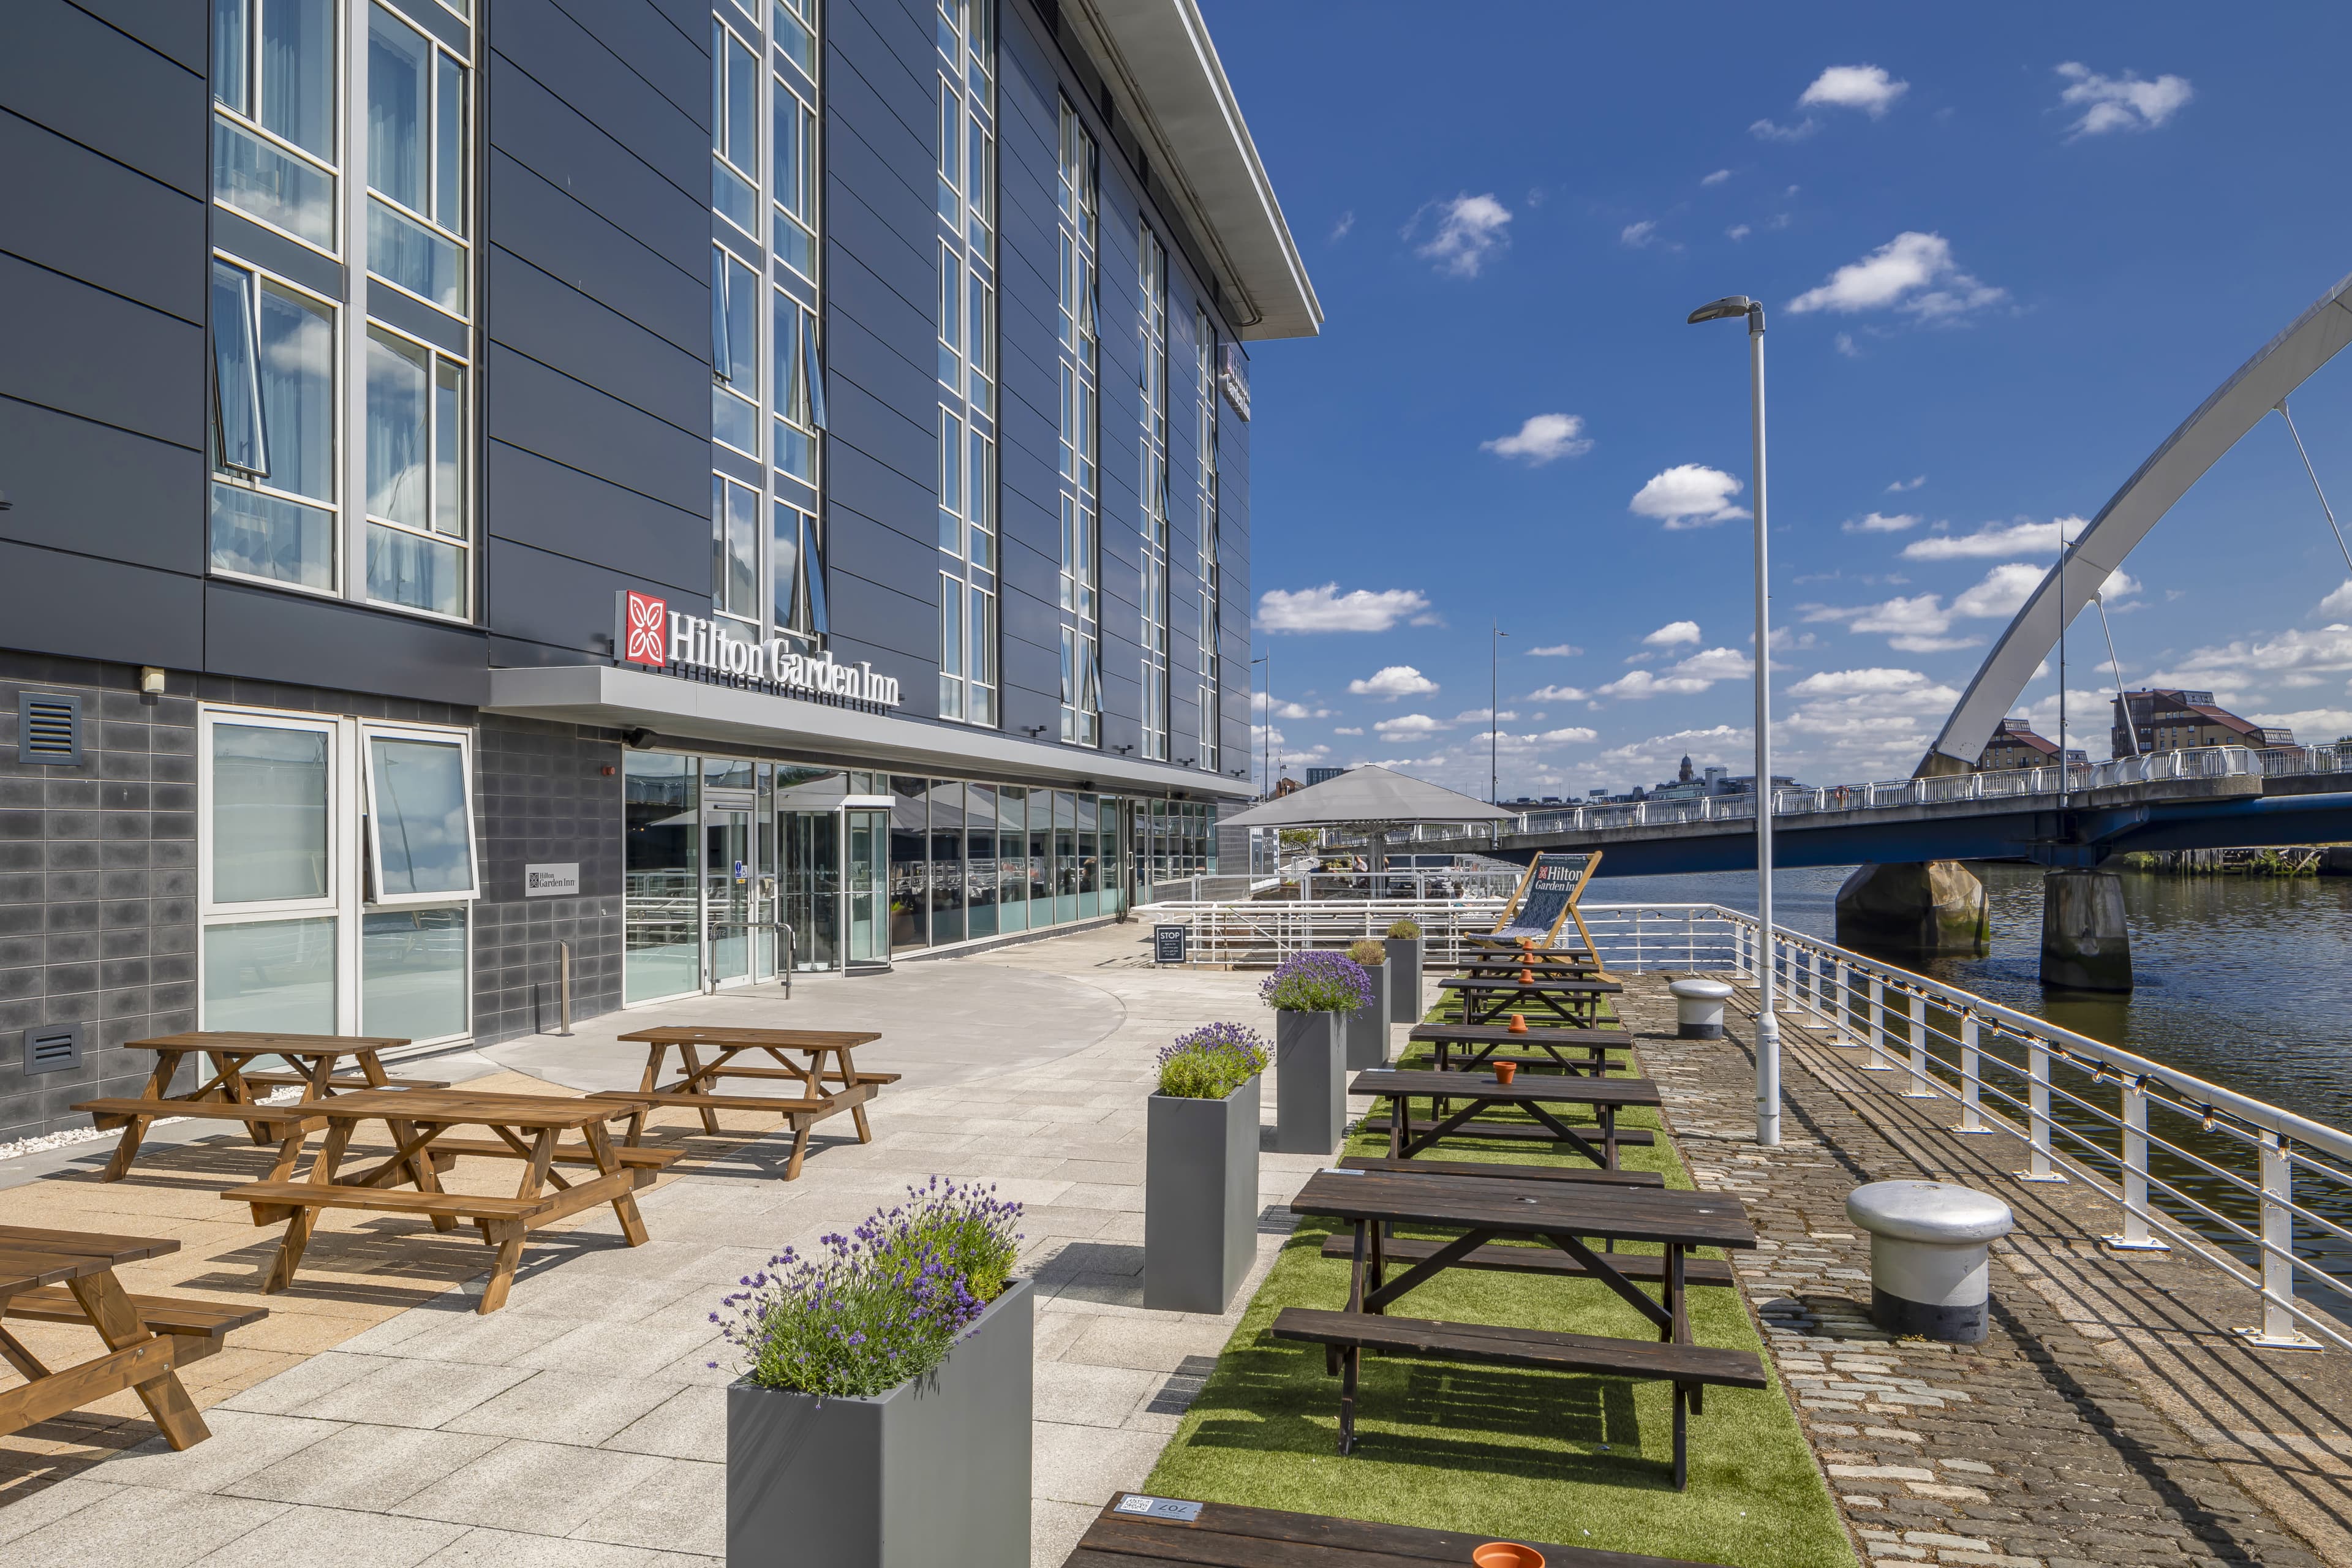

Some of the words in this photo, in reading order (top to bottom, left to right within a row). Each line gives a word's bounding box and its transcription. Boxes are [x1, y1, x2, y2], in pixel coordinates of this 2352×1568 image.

[1233, 352, 1250, 404] Hilton
[668, 611, 764, 678] Hilton
[767, 638, 861, 698] Garden
[859, 662, 900, 706] Inn
[1547, 866, 1583, 881] Hilton
[540, 878, 563, 888] Garden
[564, 878, 575, 886] Inn
[1535, 880, 1565, 891] Garden
[1566, 881, 1578, 891] In
[1158, 1504, 1188, 1513] 707
